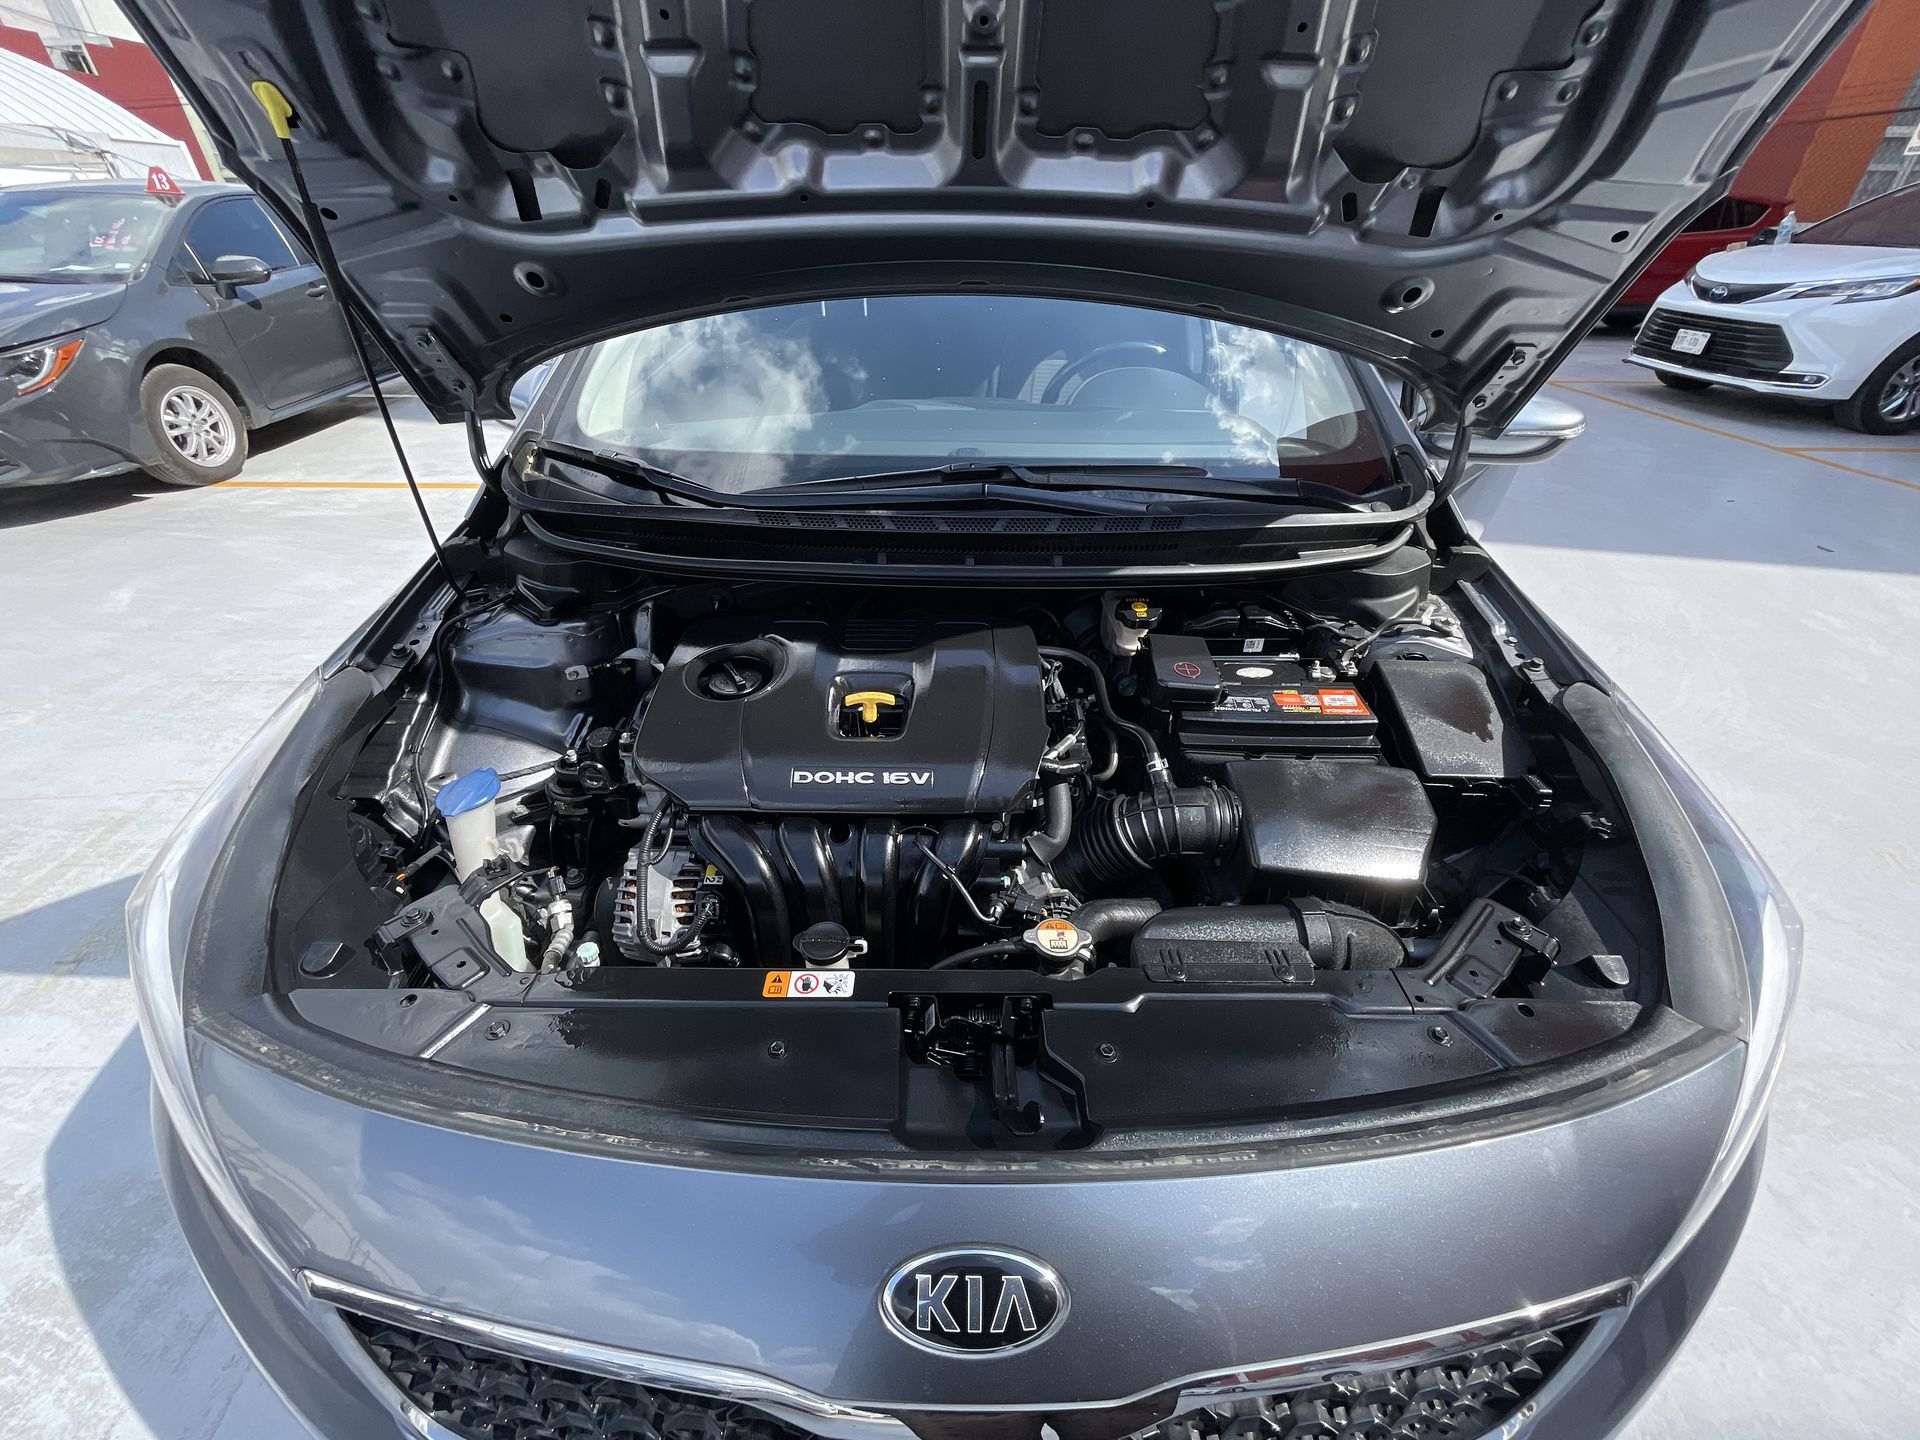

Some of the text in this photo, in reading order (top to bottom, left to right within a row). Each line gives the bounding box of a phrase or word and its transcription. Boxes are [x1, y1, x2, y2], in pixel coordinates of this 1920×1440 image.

[152, 173, 170, 190] 13
[793, 771, 931, 785] DOHC 16V
[915, 1273, 1037, 1334] KIA
